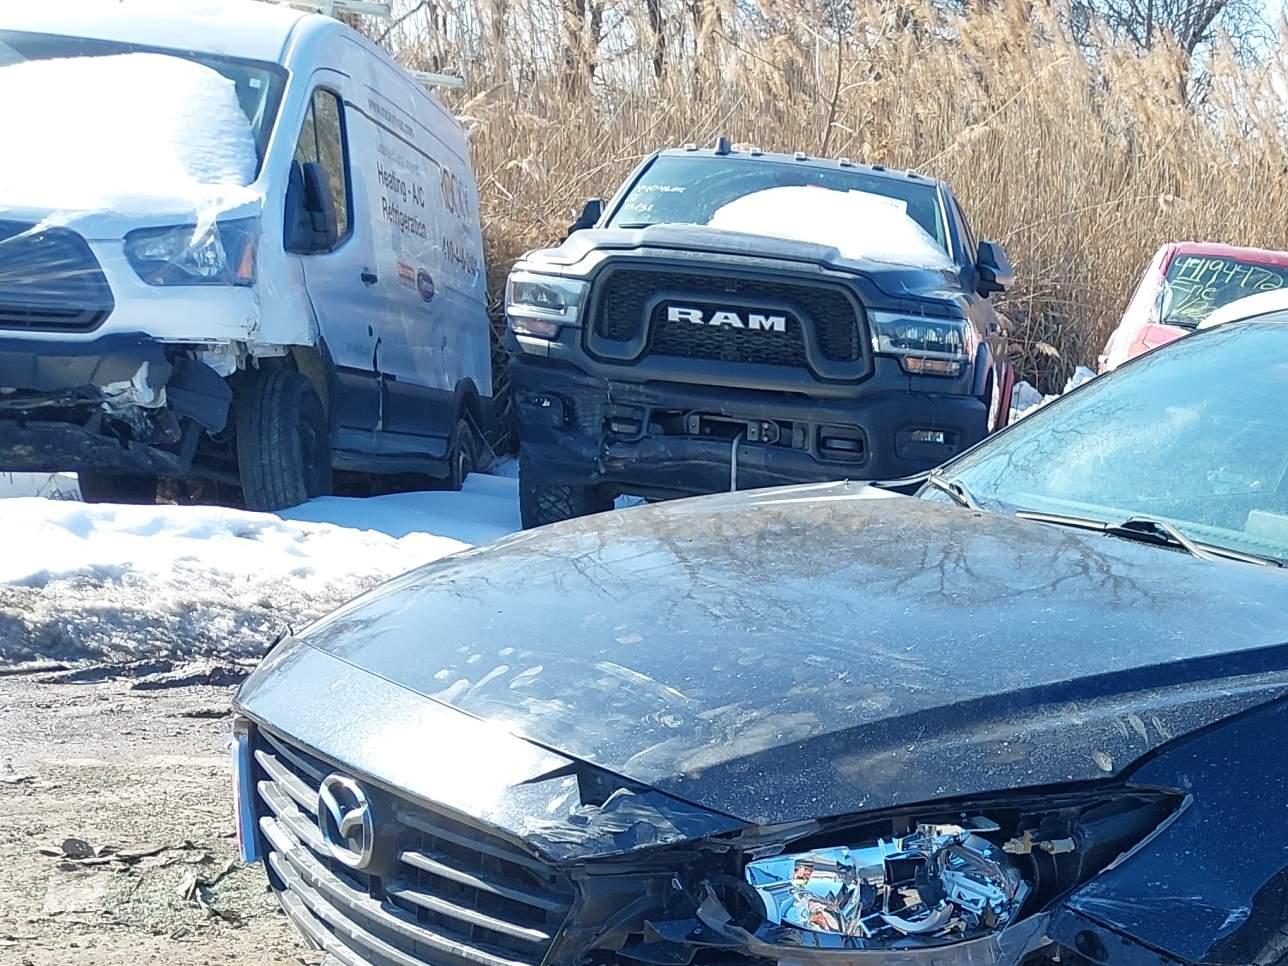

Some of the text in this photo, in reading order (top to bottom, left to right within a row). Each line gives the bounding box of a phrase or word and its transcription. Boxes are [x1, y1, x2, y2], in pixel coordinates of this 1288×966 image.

[376, 160, 408, 203] Heating
[381, 195, 427, 240] Refrigeration
[667, 305, 786, 333] RAM
